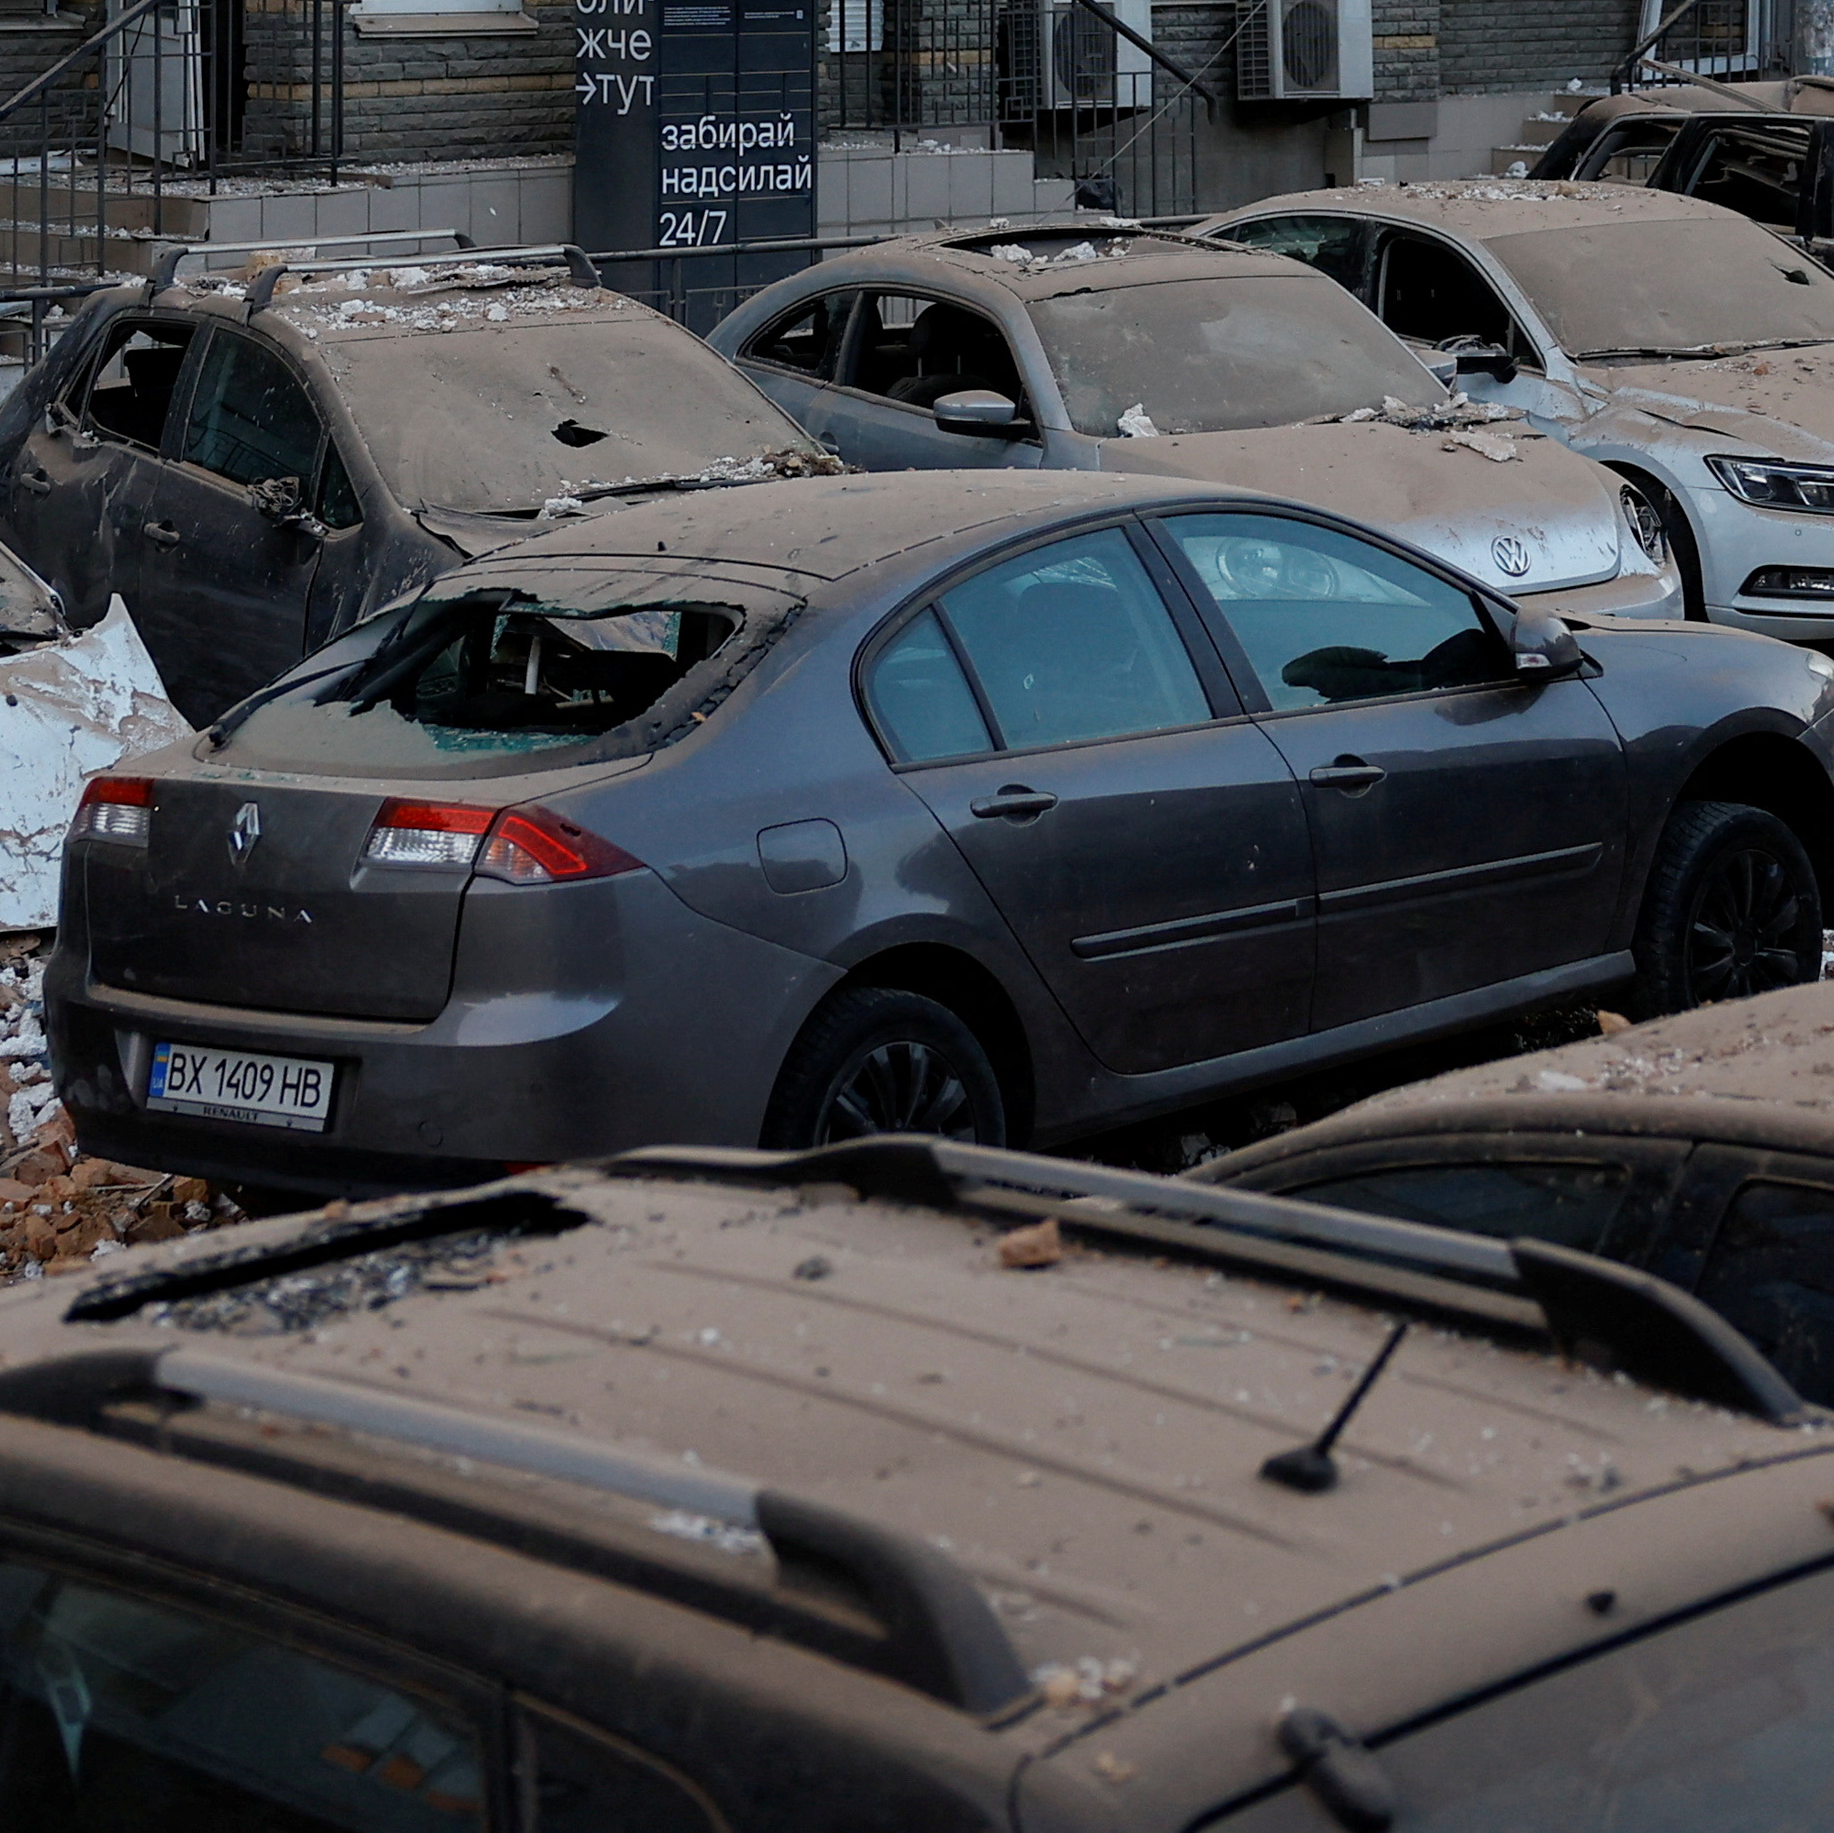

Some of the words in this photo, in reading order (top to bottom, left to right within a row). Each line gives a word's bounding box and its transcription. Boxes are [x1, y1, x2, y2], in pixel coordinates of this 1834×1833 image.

[575, 27, 653, 61] жче
[595, 73, 656, 116] тут
[661, 112, 795, 157] забирай
[662, 154, 812, 198] надсилай
[658, 209, 728, 247] 24/7
[174, 894, 313, 924] LAGUNA
[168, 1052, 208, 1095] BX
[214, 1058, 275, 1103] 1409
[279, 1065, 322, 1109] HB
[202, 1105, 259, 1123] RENAULT
